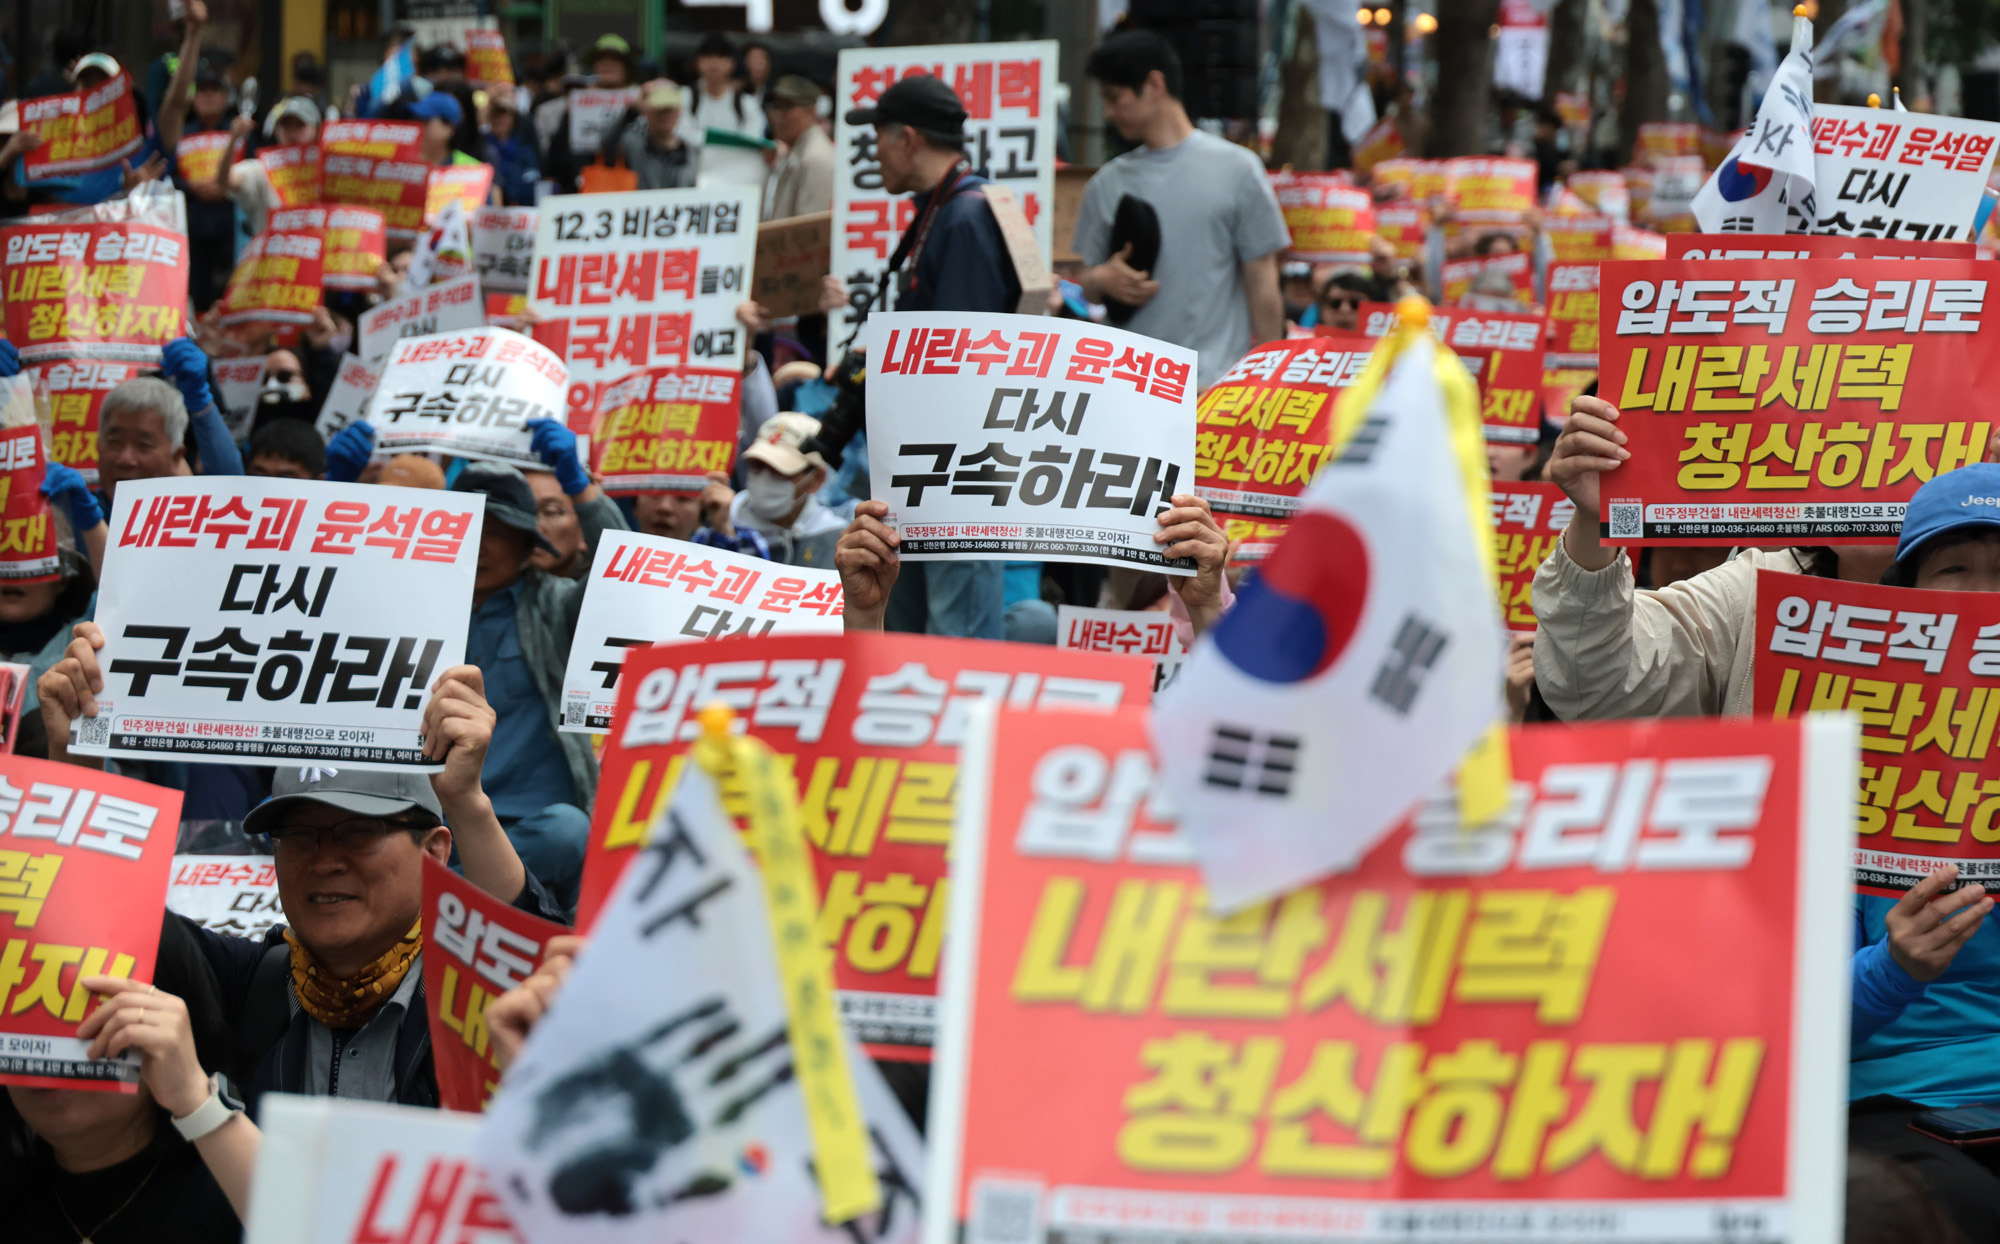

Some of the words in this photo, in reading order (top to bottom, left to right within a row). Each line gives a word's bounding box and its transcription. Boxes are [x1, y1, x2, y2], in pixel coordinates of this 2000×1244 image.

[1898, 126, 1996, 173] 윤석열
[1837, 167, 1911, 208] 다시
[622, 201, 740, 239] 비상계엄
[6, 232, 91, 266] 압도적
[94, 231, 181, 268] 승리로
[7, 264, 147, 303] 내란세력
[28, 302, 181, 341] 청산하자!
[1616, 279, 1796, 335] 압도적
[1807, 278, 1988, 333] 승리로
[1452, 317, 1541, 351] 승리로
[397, 335, 496, 366] 내란수괴
[496, 340, 568, 388] 윤석열
[443, 363, 507, 389] 다시
[880, 328, 1061, 378] 내란수괴
[1065, 337, 1191, 404] 윤석열
[1619, 344, 1914, 412] 내란세력
[654, 374, 734, 404] 승리로
[982, 387, 1091, 435] 다시
[890, 442, 1181, 519] 구속하라!
[118, 494, 309, 552] 내란수괴
[310, 501, 474, 564] 윤석열
[1654, 506, 1725, 519] 민주정부건설!
[1728, 505, 1801, 519] 내란세력청산!
[1804, 505, 1884, 519] 촛불대행진으로
[1655, 524, 1671, 534] 후원
[1678, 524, 1709, 534] 신한은행
[1711, 524, 1775, 533] 100-036-164860
[1776, 524, 1808, 533] 촛불행동
[1815, 525, 1833, 533] ARS
[1834, 524, 1889, 533] 060-707-3300
[905, 525, 958, 538] 민주정부건설!
[961, 526, 1022, 538] 내란세력청산!
[1025, 526, 1095, 540] 촛불대행진으로
[1097, 531, 1130, 544] 모이자!
[907, 541, 919, 550] 후원
[923, 541, 946, 550] 신한은행
[947, 541, 999, 550] 100-036-164860
[1000, 541, 1029, 550] 촛불행동
[1034, 542, 1049, 550] ARS
[1050, 543, 1099, 553] 060-707-3300
[1126, 549, 1138, 560] 1만
[1149, 553, 1163, 563] 여러
[218, 563, 338, 618] 다시
[602, 544, 762, 605] 내란수괴
[758, 577, 845, 616] 윤석
[1067, 619, 1175, 654] 내란수괴
[1769, 596, 1958, 674] 압도적
[109, 624, 445, 710] 구속하라!
[620, 658, 846, 749] 압도적
[121, 735, 138, 746] 후원
[143, 737, 174, 749] 신한은행
[175, 739, 234, 751] 100-036-164860
[235, 742, 264, 753] 촛불행동
[271, 744, 287, 753] ARS
[288, 745, 339, 756] 060-707-3300
[340, 747, 351, 758] (한
[353, 748, 368, 758] 통에
[370, 749, 383, 759] 1만
[385, 750, 395, 761] 원,
[397, 752, 412, 761] 여러
[122, 719, 190, 734] 민주정부건설!
[193, 722, 259, 737] 내란세력청산!
[261, 725, 336, 741] 촛불대행진으로
[338, 730, 375, 744] 모이자!
[1011, 874, 1616, 1026] 내란세력
[9, 1037, 52, 1054] 모이자!
[1114, 1032, 1767, 1181] 청산하자!
